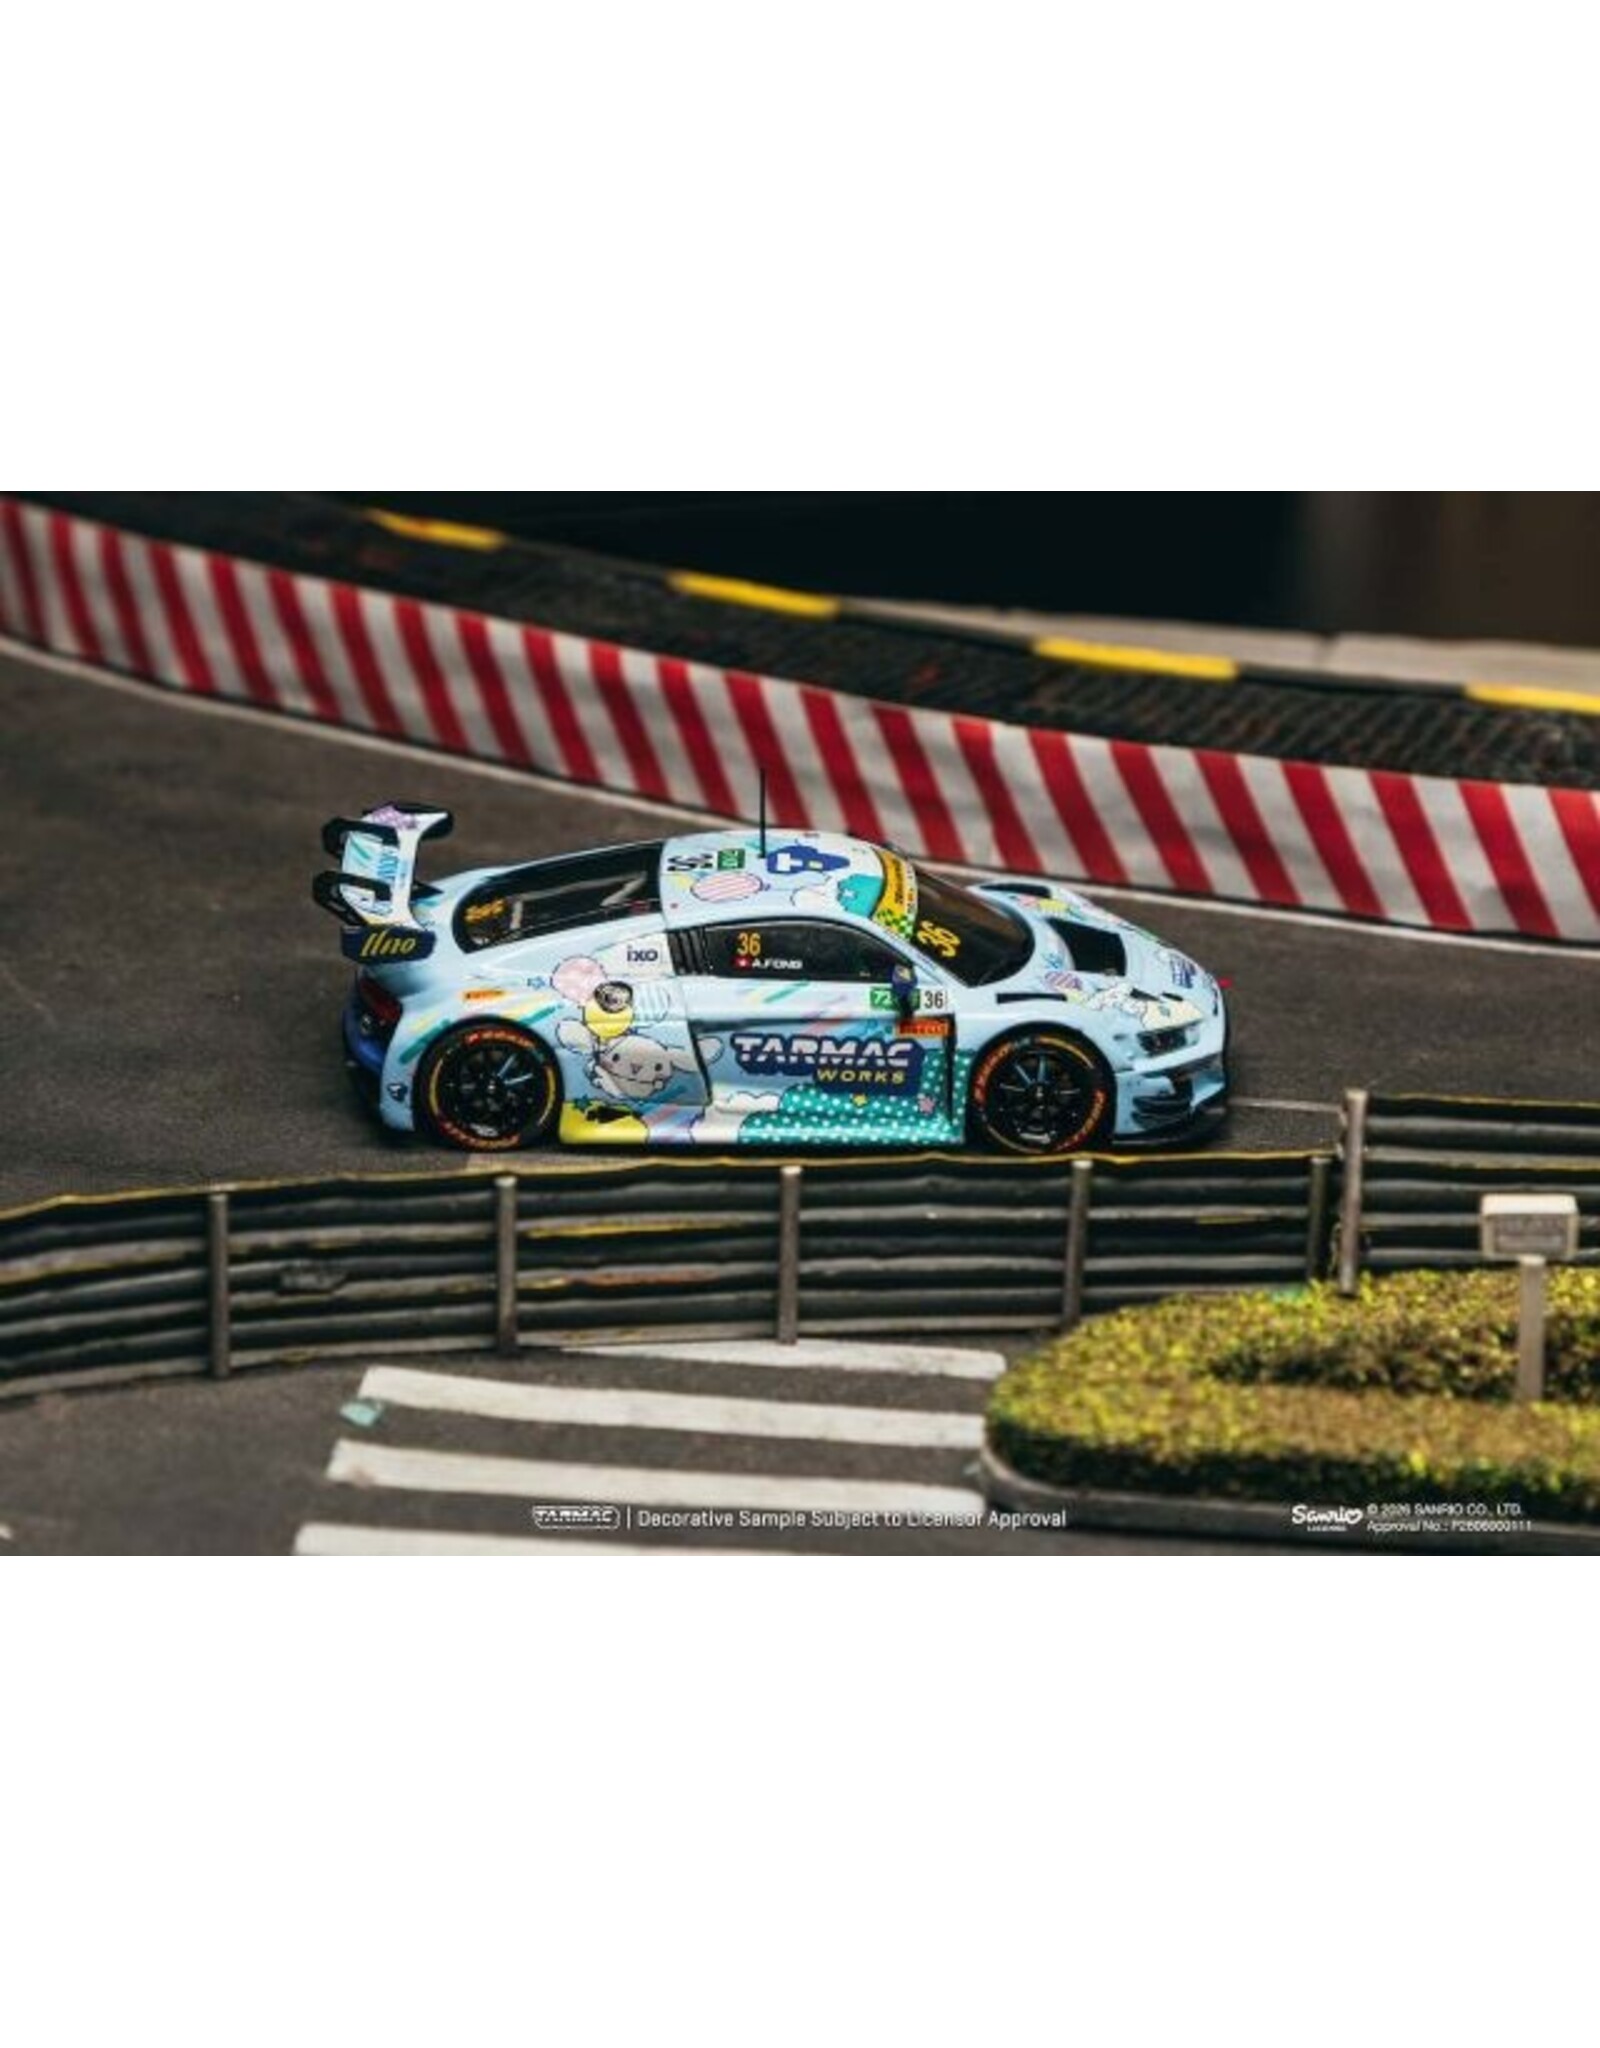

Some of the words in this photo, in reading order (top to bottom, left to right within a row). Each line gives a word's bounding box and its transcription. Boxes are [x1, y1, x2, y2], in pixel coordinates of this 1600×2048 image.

[737, 932, 761, 956] 36
[924, 990, 944, 1009] 36
[733, 1036, 913, 1067] TARMAC
[816, 1068, 906, 1084] WORKS
